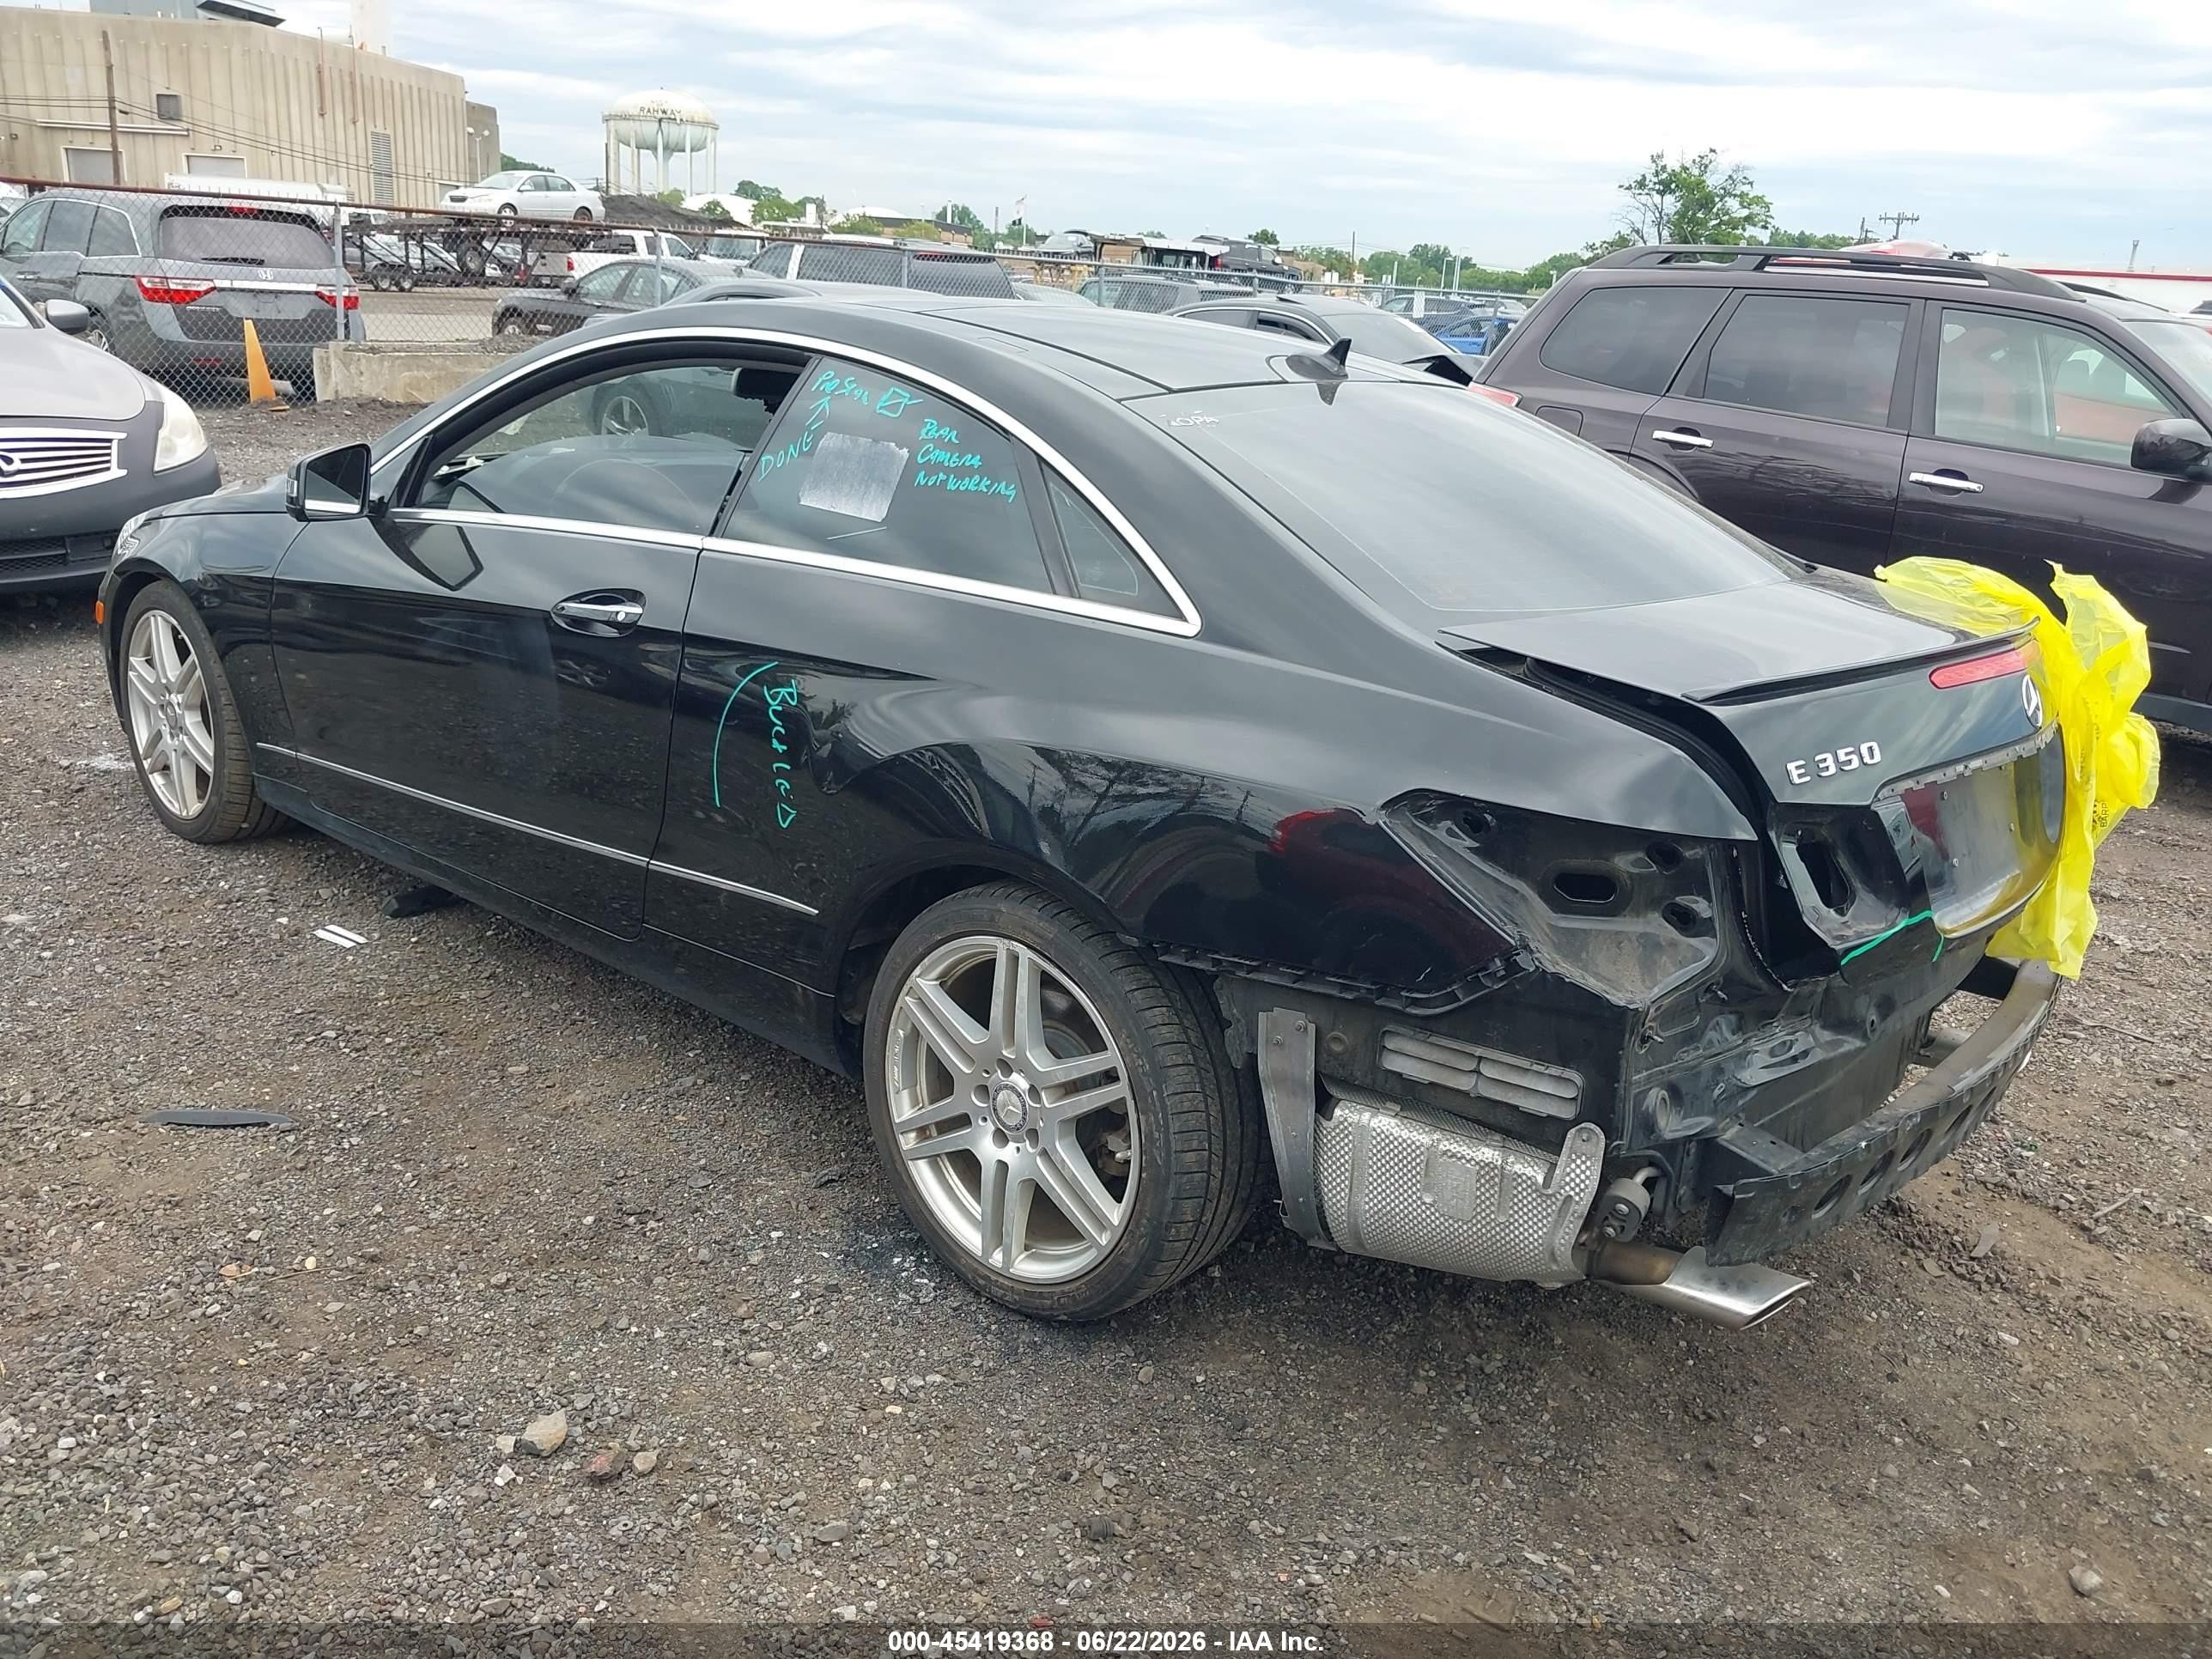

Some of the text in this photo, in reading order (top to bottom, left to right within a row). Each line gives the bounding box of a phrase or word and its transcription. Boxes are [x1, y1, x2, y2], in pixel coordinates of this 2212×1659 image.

[639, 106, 682, 116] RAHWAY
[757, 431, 814, 483] DONE
[916, 443, 982, 469] CAMERA
[914, 470, 1017, 503] NOT WORKING
[1785, 741, 1882, 785] E 350
